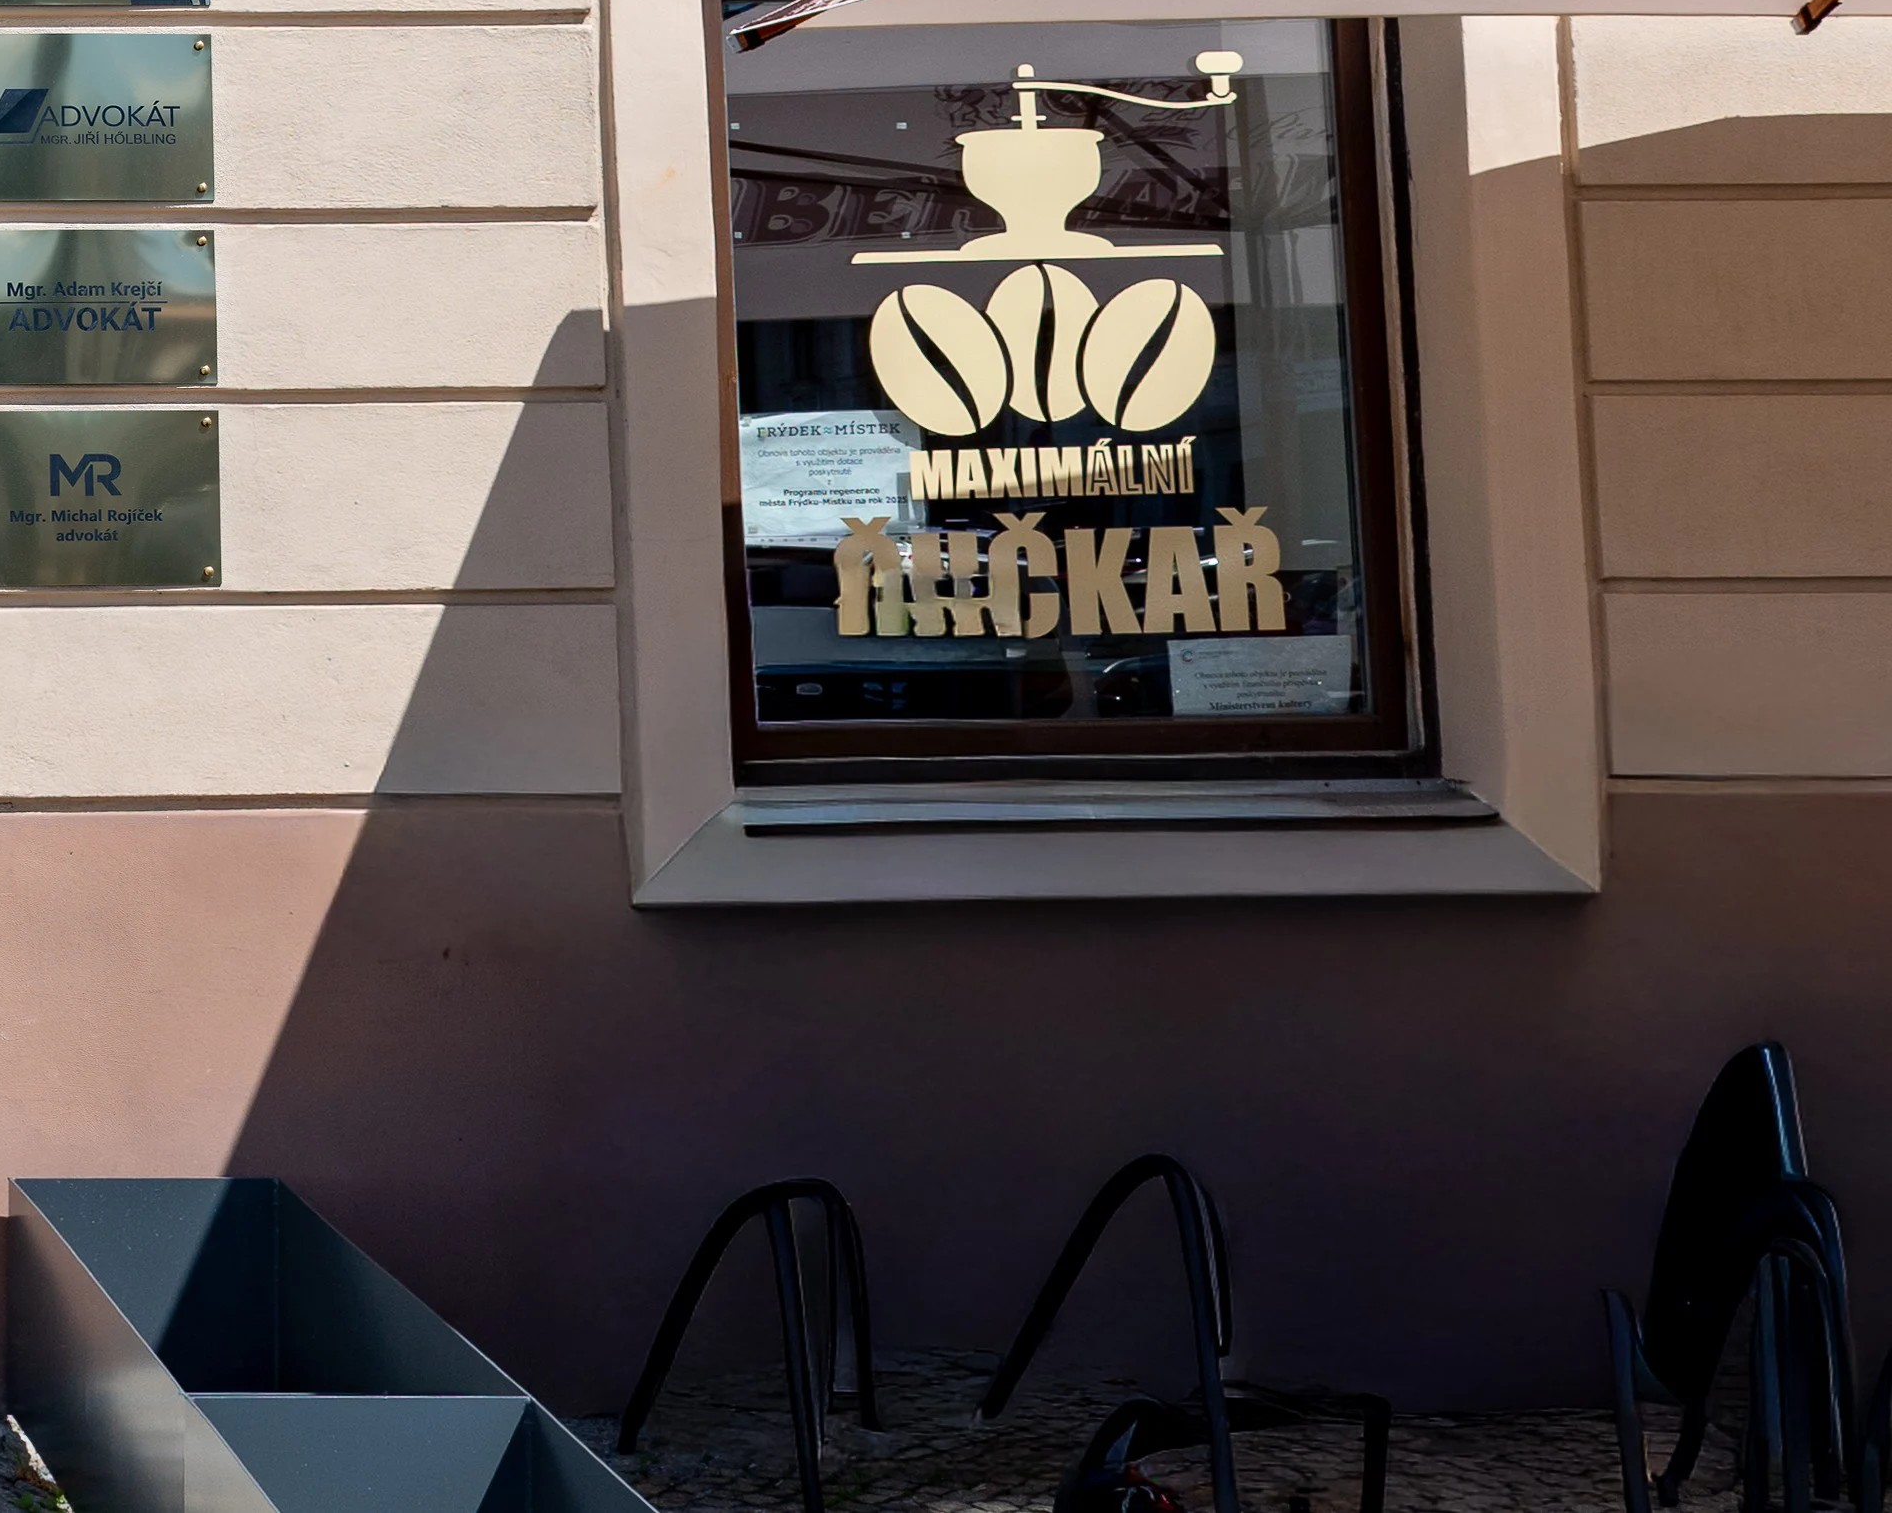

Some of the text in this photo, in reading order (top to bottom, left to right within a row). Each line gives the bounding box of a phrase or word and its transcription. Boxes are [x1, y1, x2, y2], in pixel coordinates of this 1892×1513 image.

[38, 100, 180, 127] ADVOKÁT
[40, 134, 72, 145] MGR.
[73, 131, 100, 145] JIŘÍ
[6, 281, 162, 300] Mgr. Adam Krejčí
[8, 302, 162, 332] ADVOKÁT
[49, 453, 123, 497] MR
[909, 435, 1196, 501] MAXIMÁLNÍ
[759, 498, 786, 507] města
[868, 496, 883, 505] rok
[783, 488, 880, 498] Programu regenerace
[9, 509, 163, 526] Mgr. Michal Rojíček
[55, 528, 119, 542] advokát
